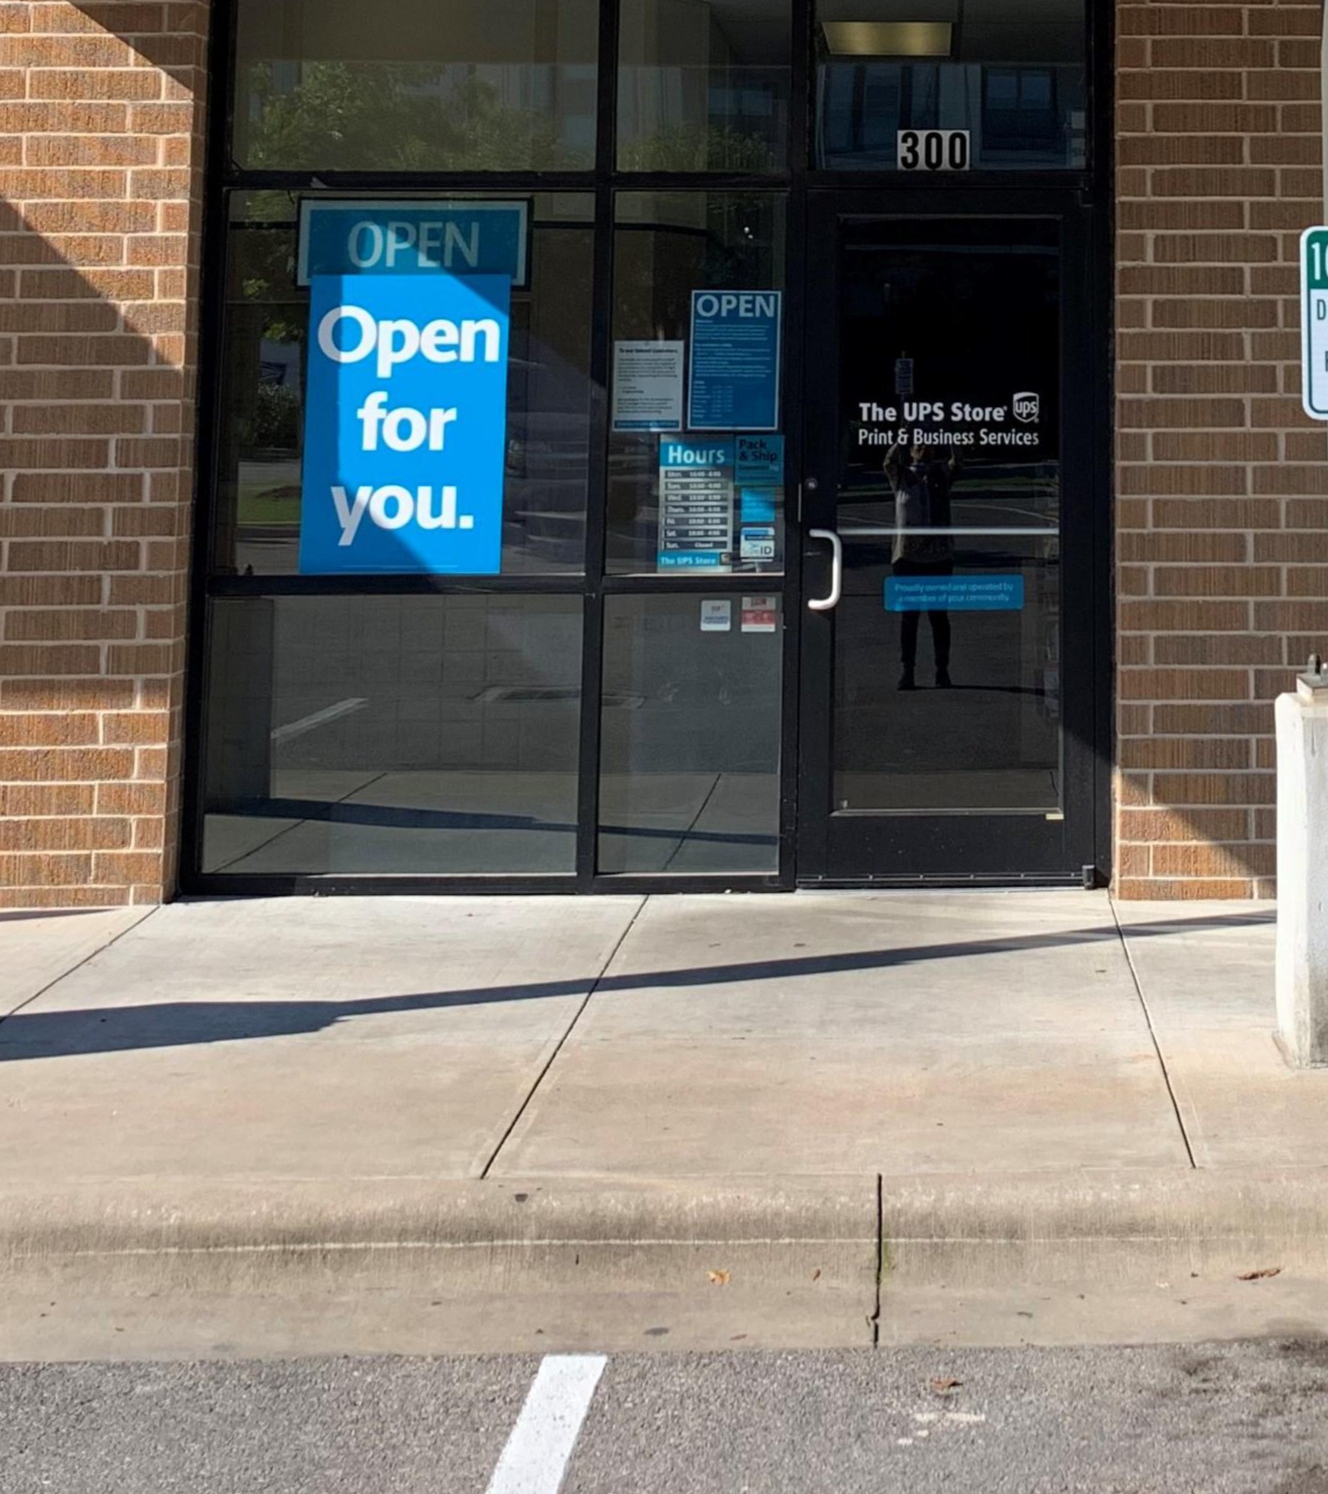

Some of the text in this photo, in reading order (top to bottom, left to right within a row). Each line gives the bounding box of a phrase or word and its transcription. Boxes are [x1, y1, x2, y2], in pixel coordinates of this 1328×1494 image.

[899, 131, 969, 169] 300
[348, 221, 480, 268] OPEN
[696, 294, 776, 318] OPEN
[317, 305, 501, 378] Open
[357, 391, 458, 451] for
[859, 402, 897, 422] The
[903, 402, 945, 422] UPS
[1015, 400, 1037, 418] ups
[858, 428, 1039, 446] Print & Business Services
[667, 444, 726, 465] Hours
[330, 484, 476, 546] you.
